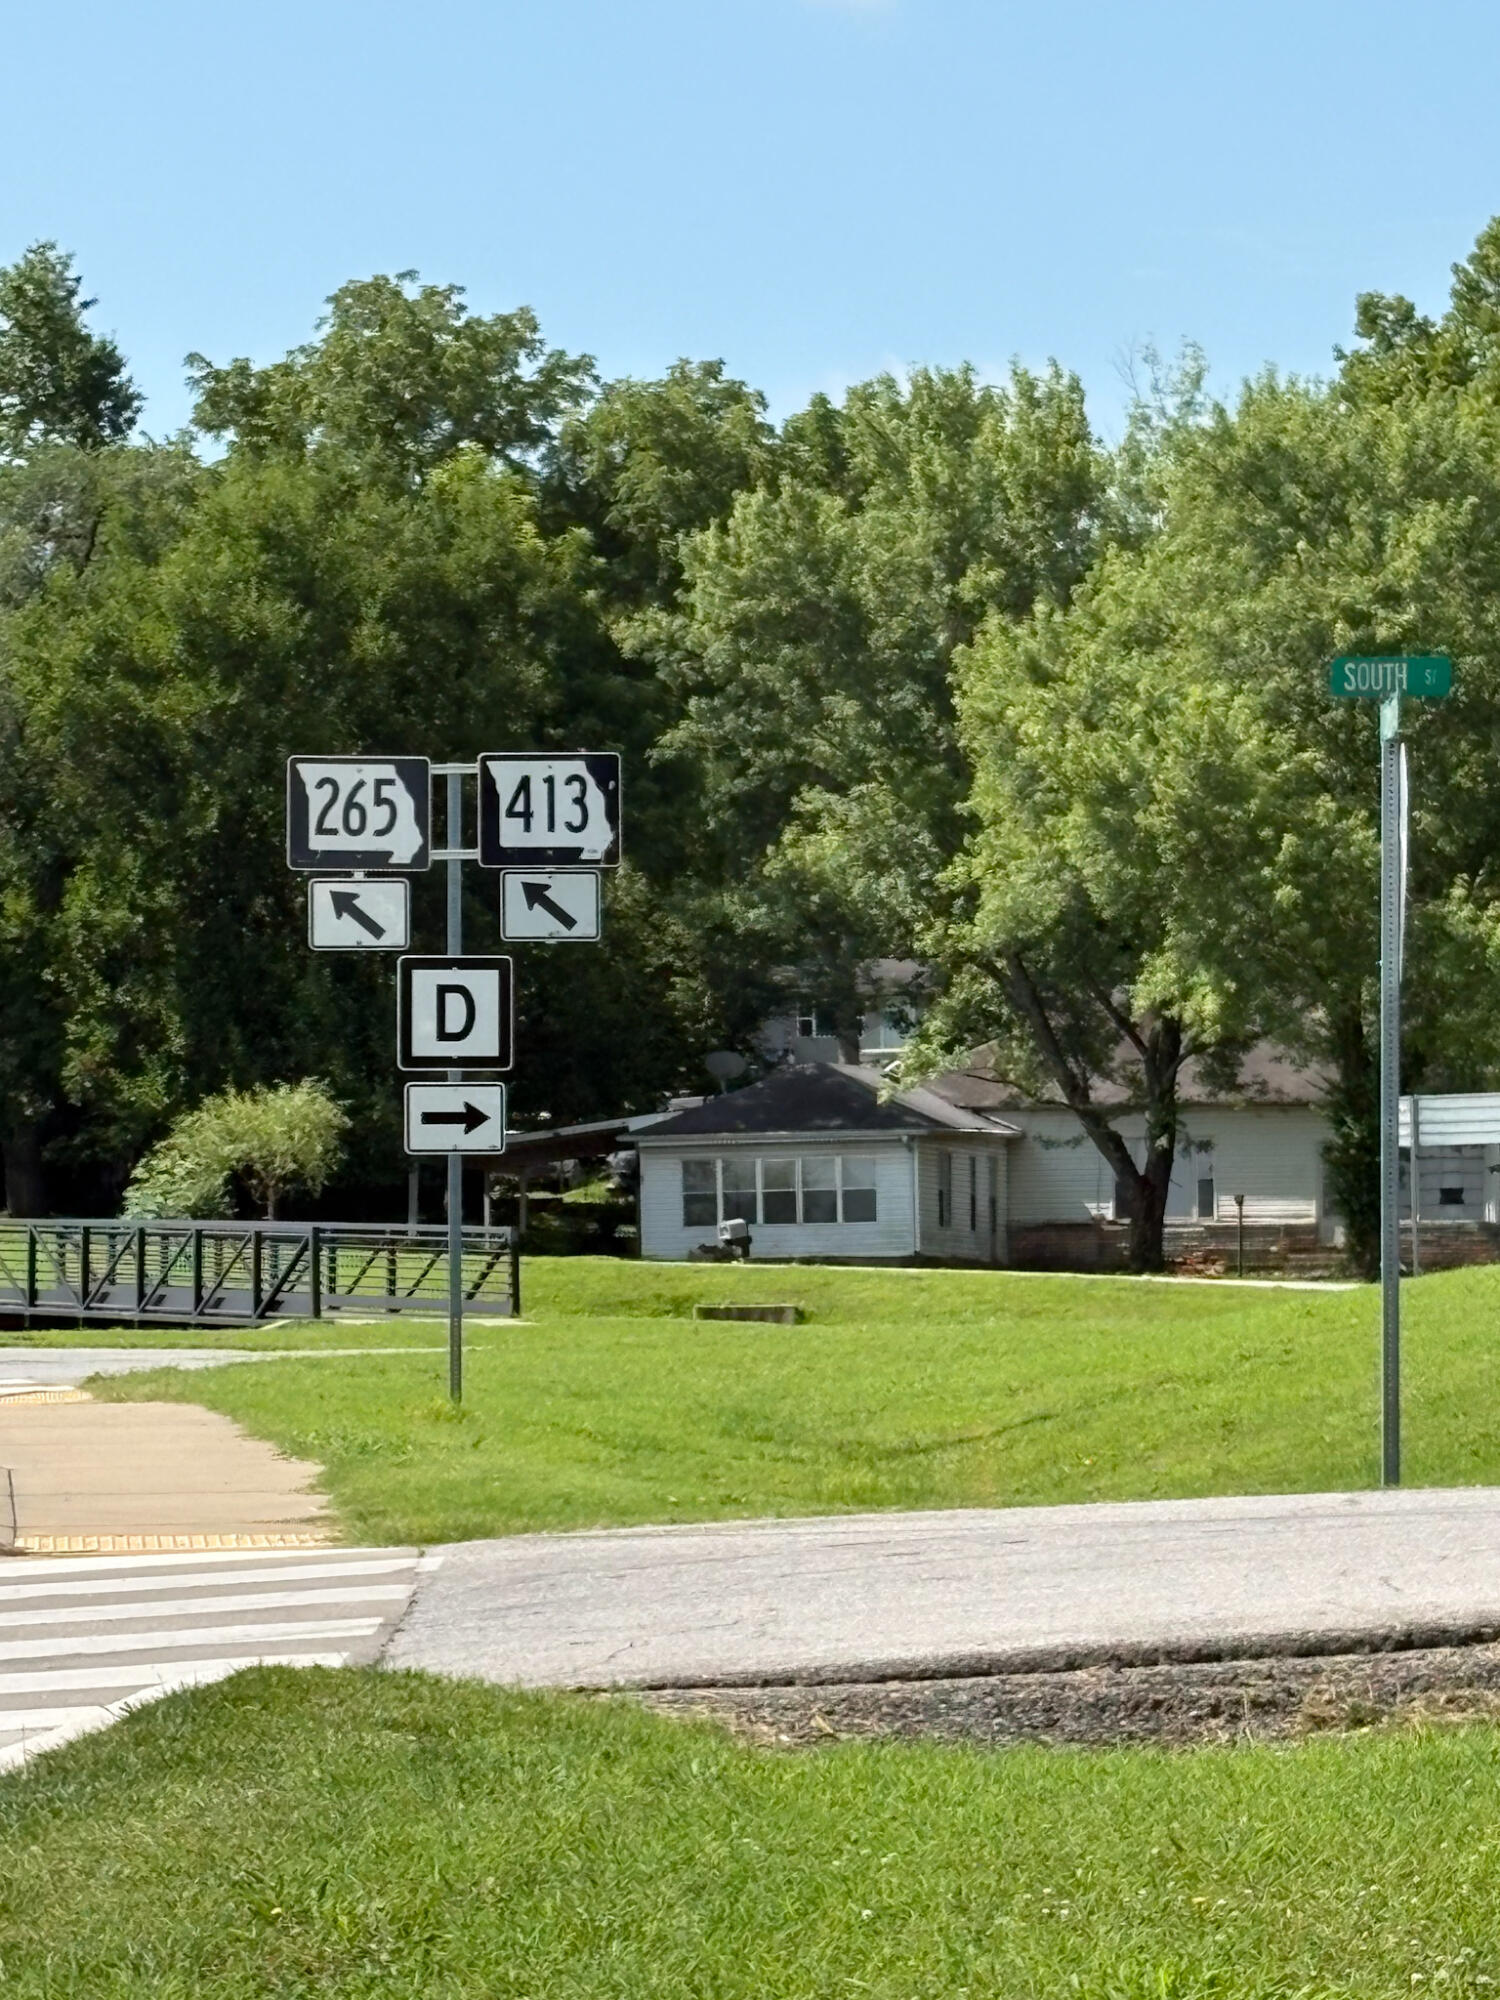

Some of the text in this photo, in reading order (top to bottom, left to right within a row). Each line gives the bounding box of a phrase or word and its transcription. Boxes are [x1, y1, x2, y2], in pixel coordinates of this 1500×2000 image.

[1343, 662, 1407, 691] SOUTH
[315, 777, 398, 837] 265
[504, 774, 589, 833] 413
[436, 984, 476, 1042] D
